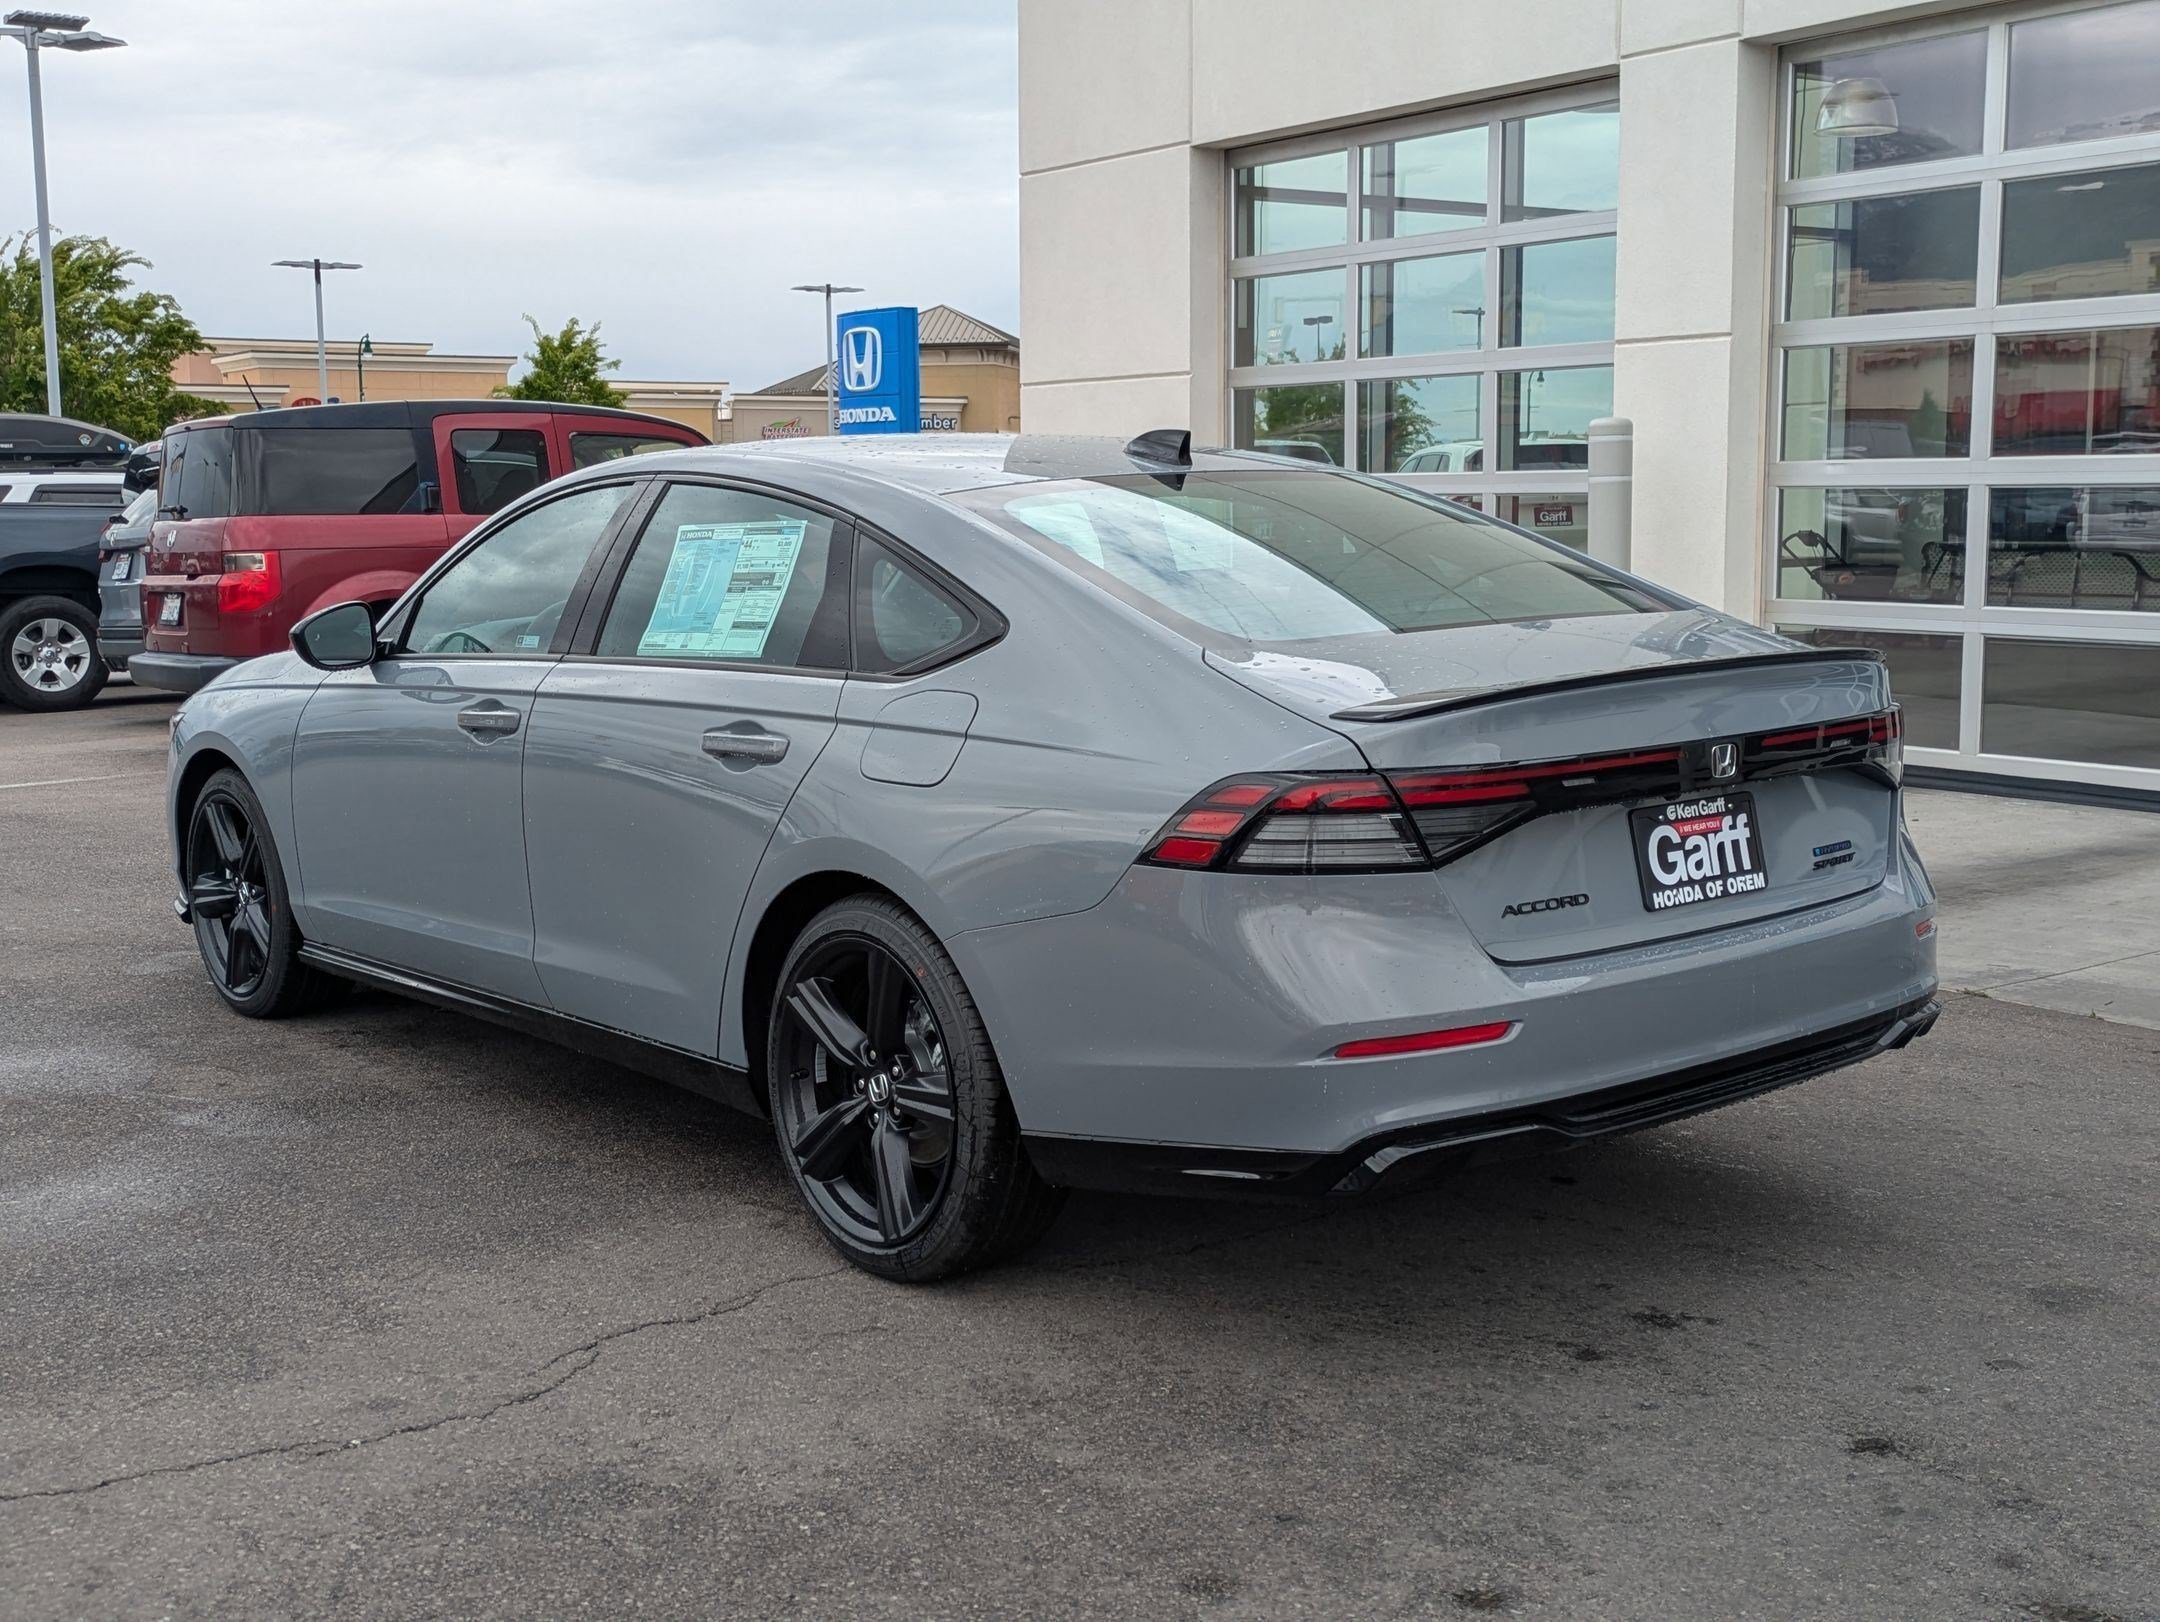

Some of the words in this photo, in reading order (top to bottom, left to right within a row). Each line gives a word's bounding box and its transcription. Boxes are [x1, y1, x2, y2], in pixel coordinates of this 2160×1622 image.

[838, 407, 896, 424] HONDA
[920, 414, 957, 430] mber
[1540, 511, 1567, 521] Garff
[686, 531, 713, 539] HONDA
[1683, 824, 1692, 833] WE
[1692, 822, 1706, 831] HEAR
[1706, 820, 1717, 829] YOU
[1648, 813, 1752, 886] Garff
[1652, 884, 1704, 909] HONDA
[1705, 880, 1724, 898] OF
[1726, 872, 1766, 894] OREM
[1501, 893, 1590, 919] ACCORD
